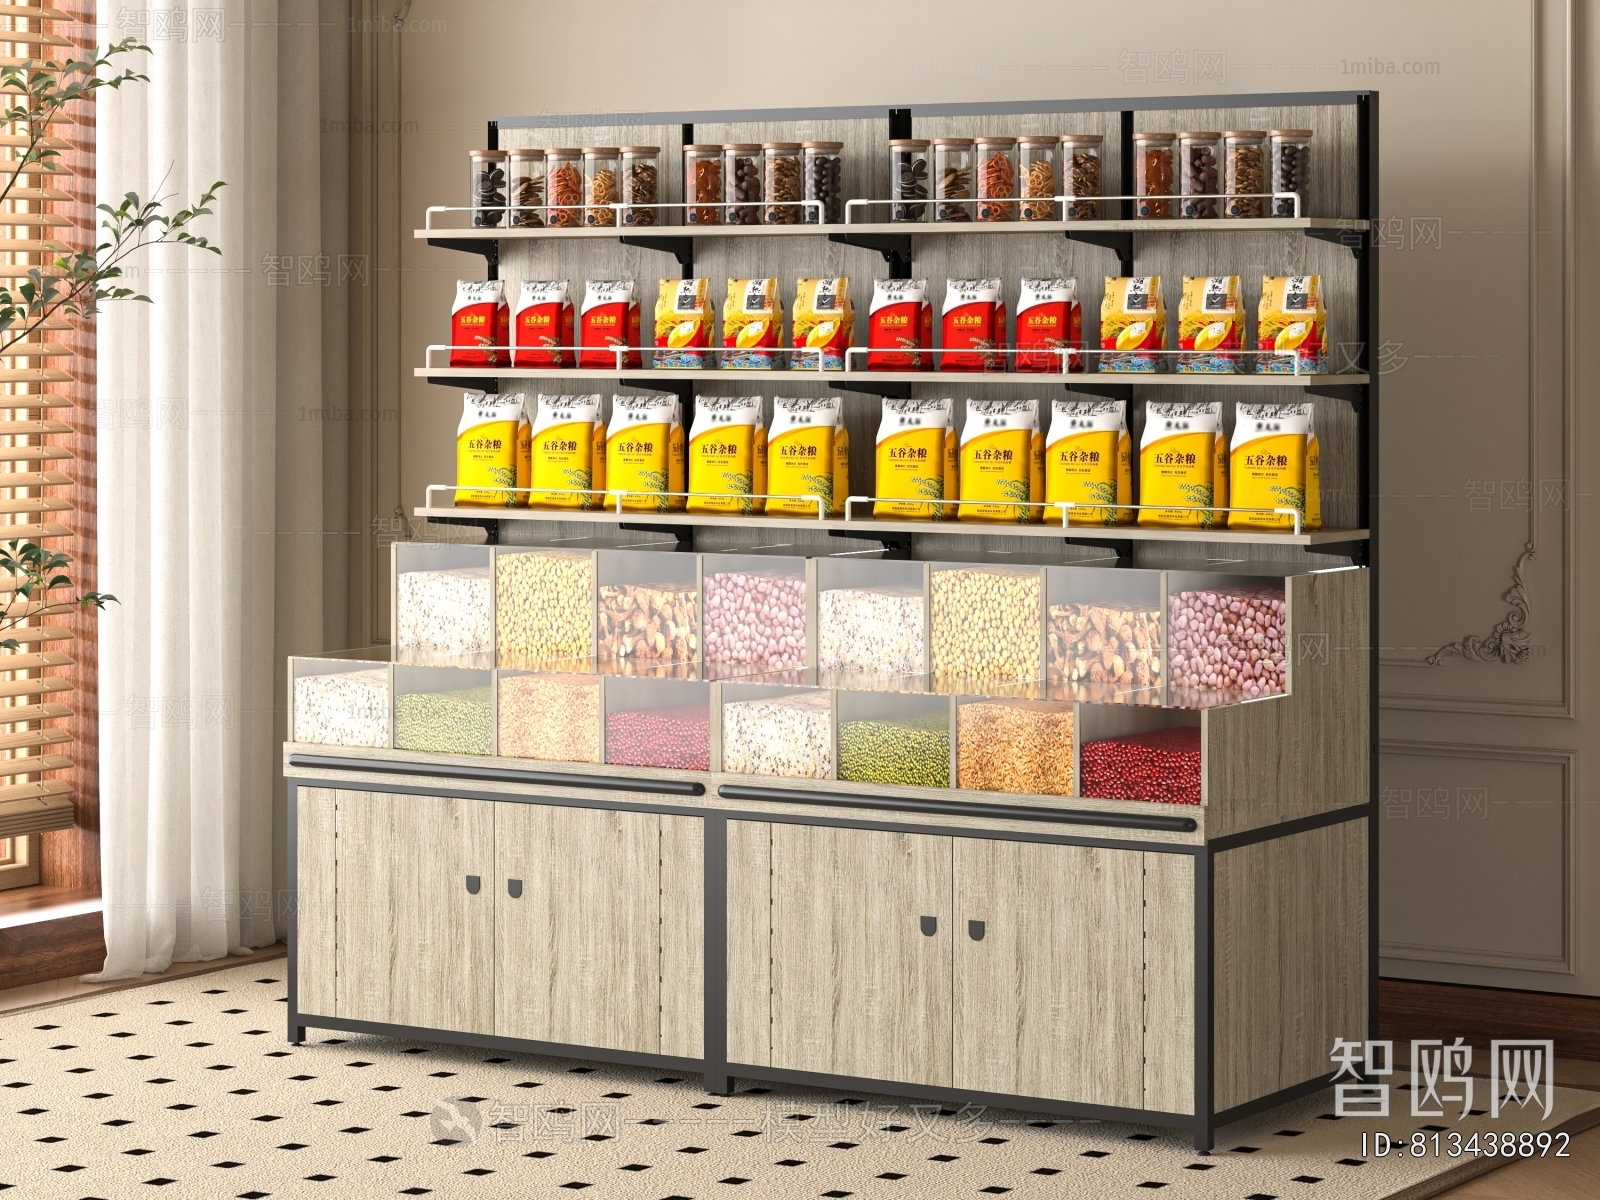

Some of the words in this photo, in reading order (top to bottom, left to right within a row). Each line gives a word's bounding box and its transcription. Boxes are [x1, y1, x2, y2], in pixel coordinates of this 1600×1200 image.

[460, 315, 486, 325] 五谷杂粮
[525, 315, 551, 325] 五谷杂粮
[590, 315, 617, 325] 五谷杂粮
[880, 315, 909, 325] 五谷杂粮
[953, 315, 982, 325] 五谷杂粮
[1028, 315, 1058, 325] 五谷杂粮
[468, 439, 502, 449] 五谷杂粮
[542, 440, 577, 451] 五谷杂粮
[617, 442, 653, 452] 五谷杂粮
[701, 443, 737, 454] 五谷杂粮
[780, 445, 817, 456] 五谷杂粮
[888, 447, 927, 458] 五谷杂粮
[973, 449, 1013, 460] 五谷杂粮
[1059, 451, 1100, 462] 五谷杂粮
[1154, 452, 1196, 464] 五谷杂粮
[1245, 454, 1288, 466] 五谷杂粮
